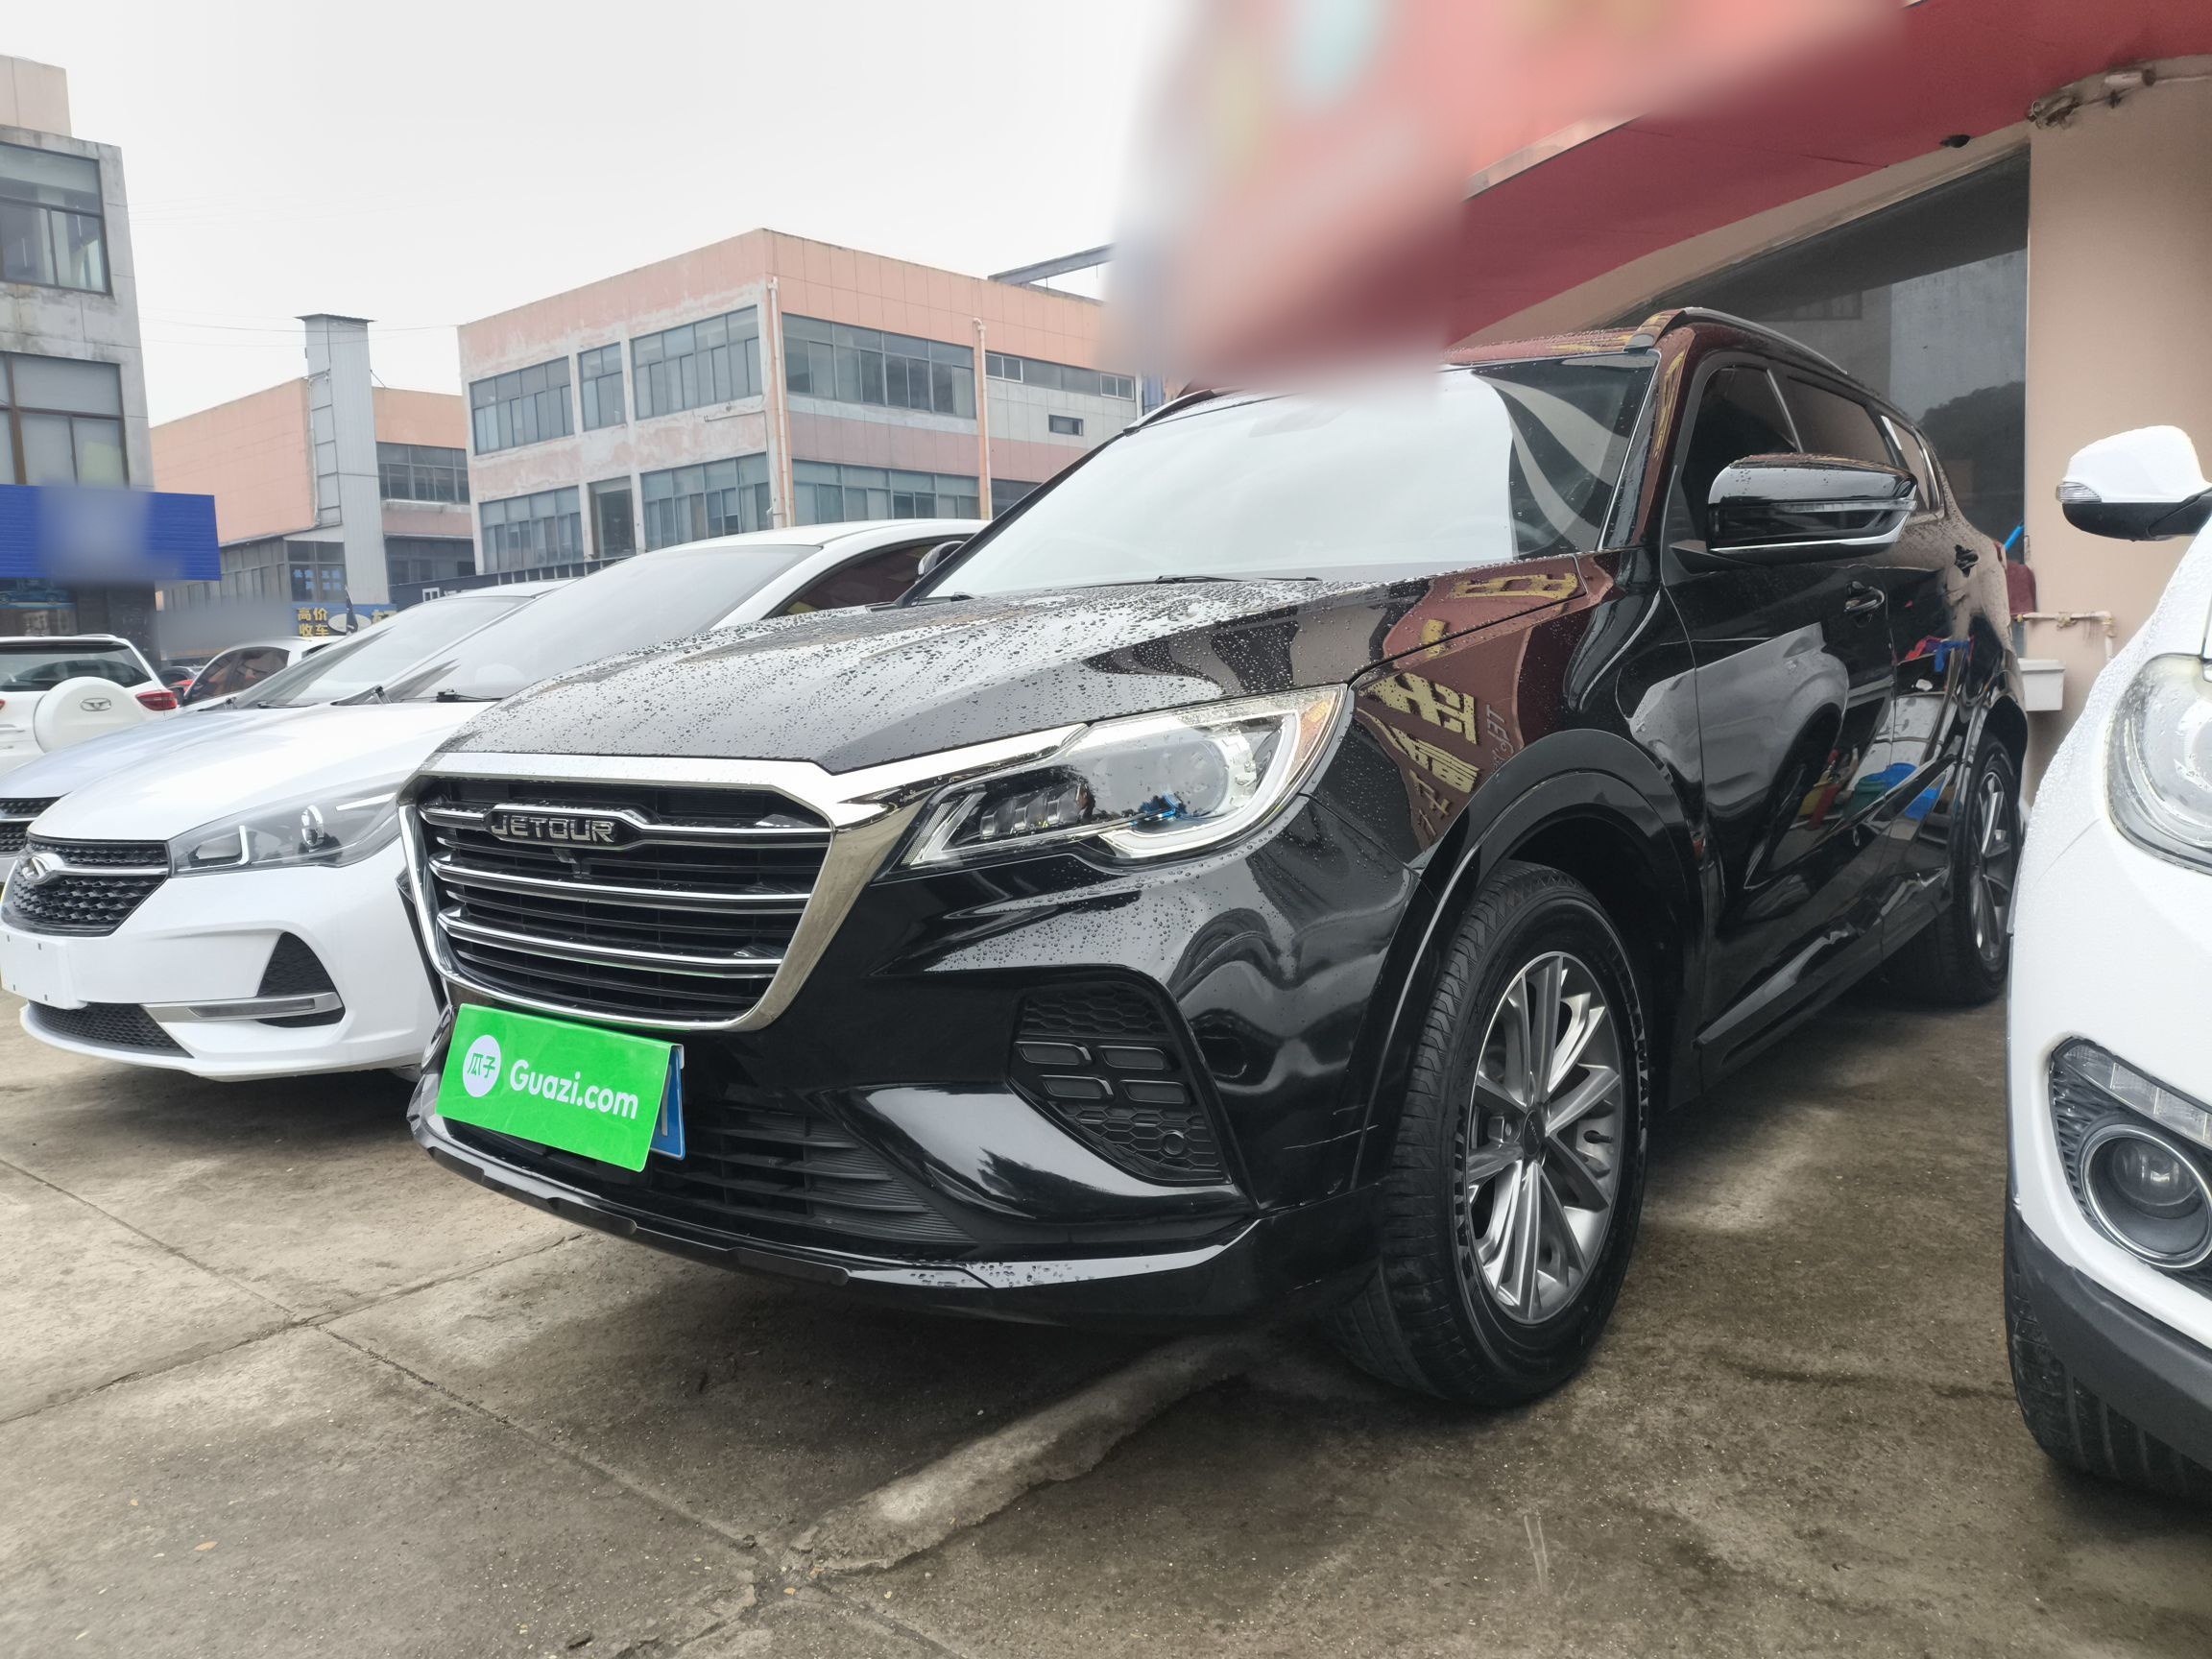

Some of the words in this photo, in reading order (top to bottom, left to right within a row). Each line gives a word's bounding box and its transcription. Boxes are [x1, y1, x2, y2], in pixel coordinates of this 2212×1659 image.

[298, 607, 327, 621] 高价
[299, 624, 329, 637] 收车
[491, 815, 614, 843] JETOUR
[467, 1052, 495, 1079] 瓜子
[509, 1059, 638, 1119] Guazi.com
